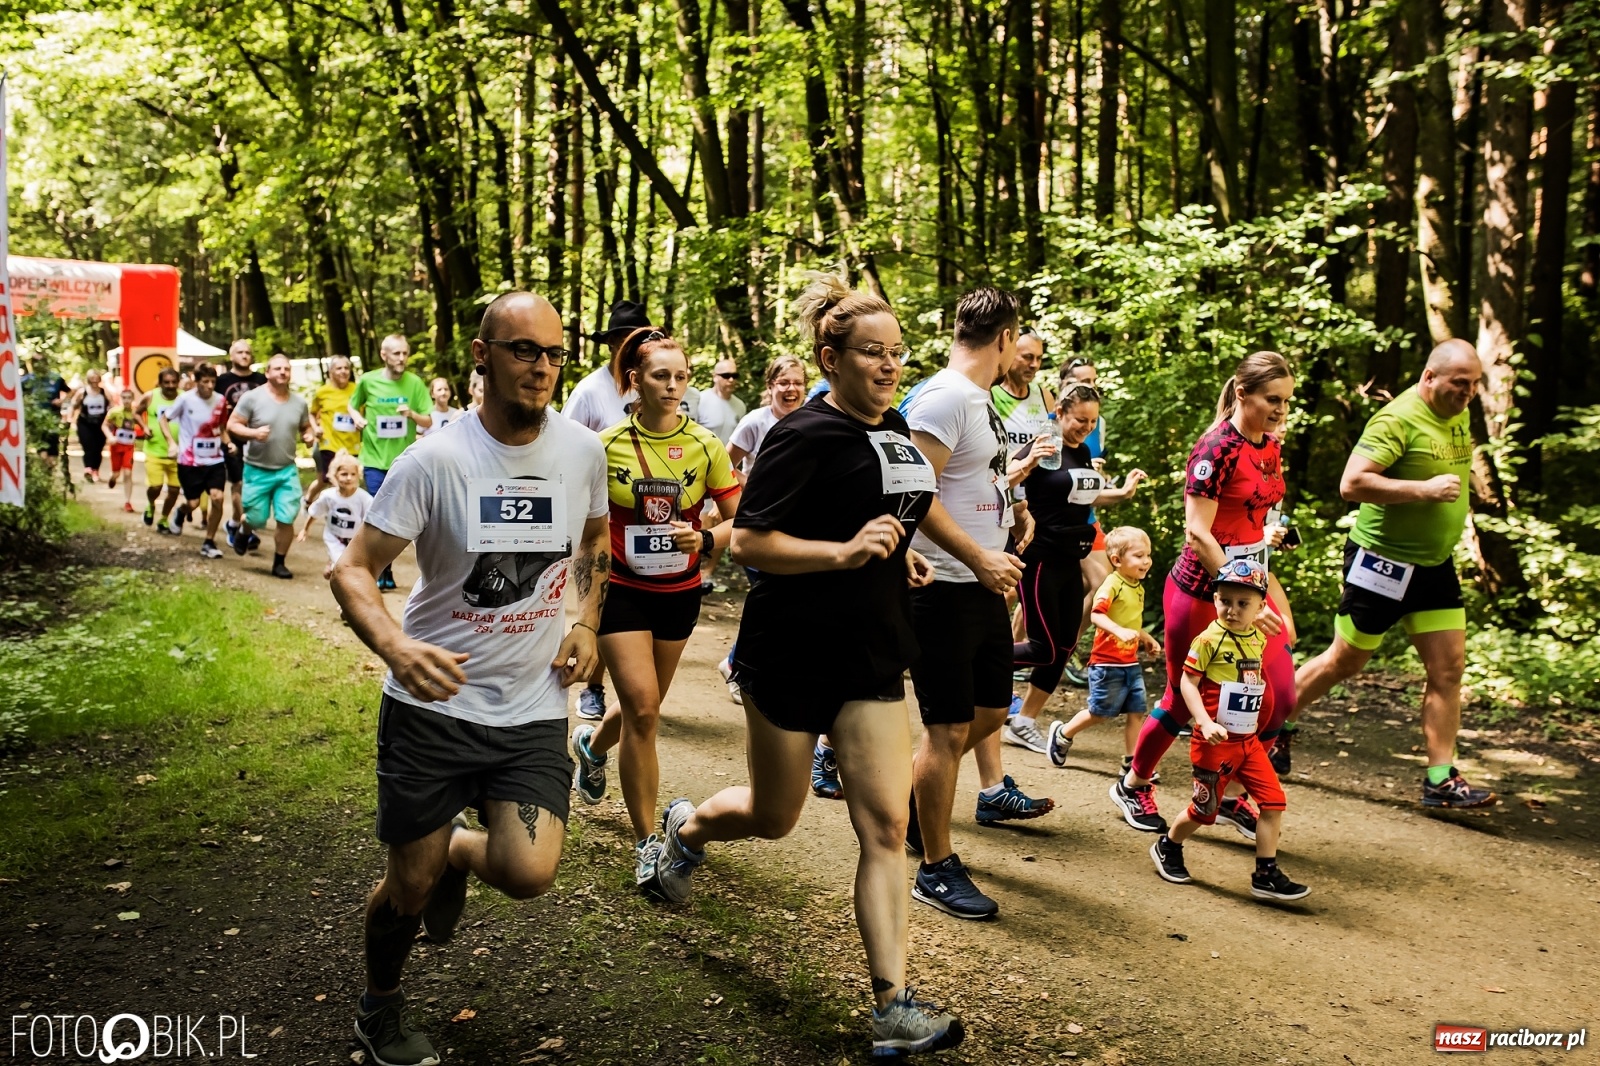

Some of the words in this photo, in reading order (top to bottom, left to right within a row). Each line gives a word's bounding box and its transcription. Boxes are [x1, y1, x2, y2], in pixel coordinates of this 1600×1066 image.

[894, 444, 914, 462] 53
[1199, 465, 1208, 476] B
[1083, 478, 1095, 489] 90
[500, 499, 533, 520] 52
[649, 536, 673, 552] 85
[1372, 560, 1394, 576] 43
[451, 610, 496, 624] MARIAN
